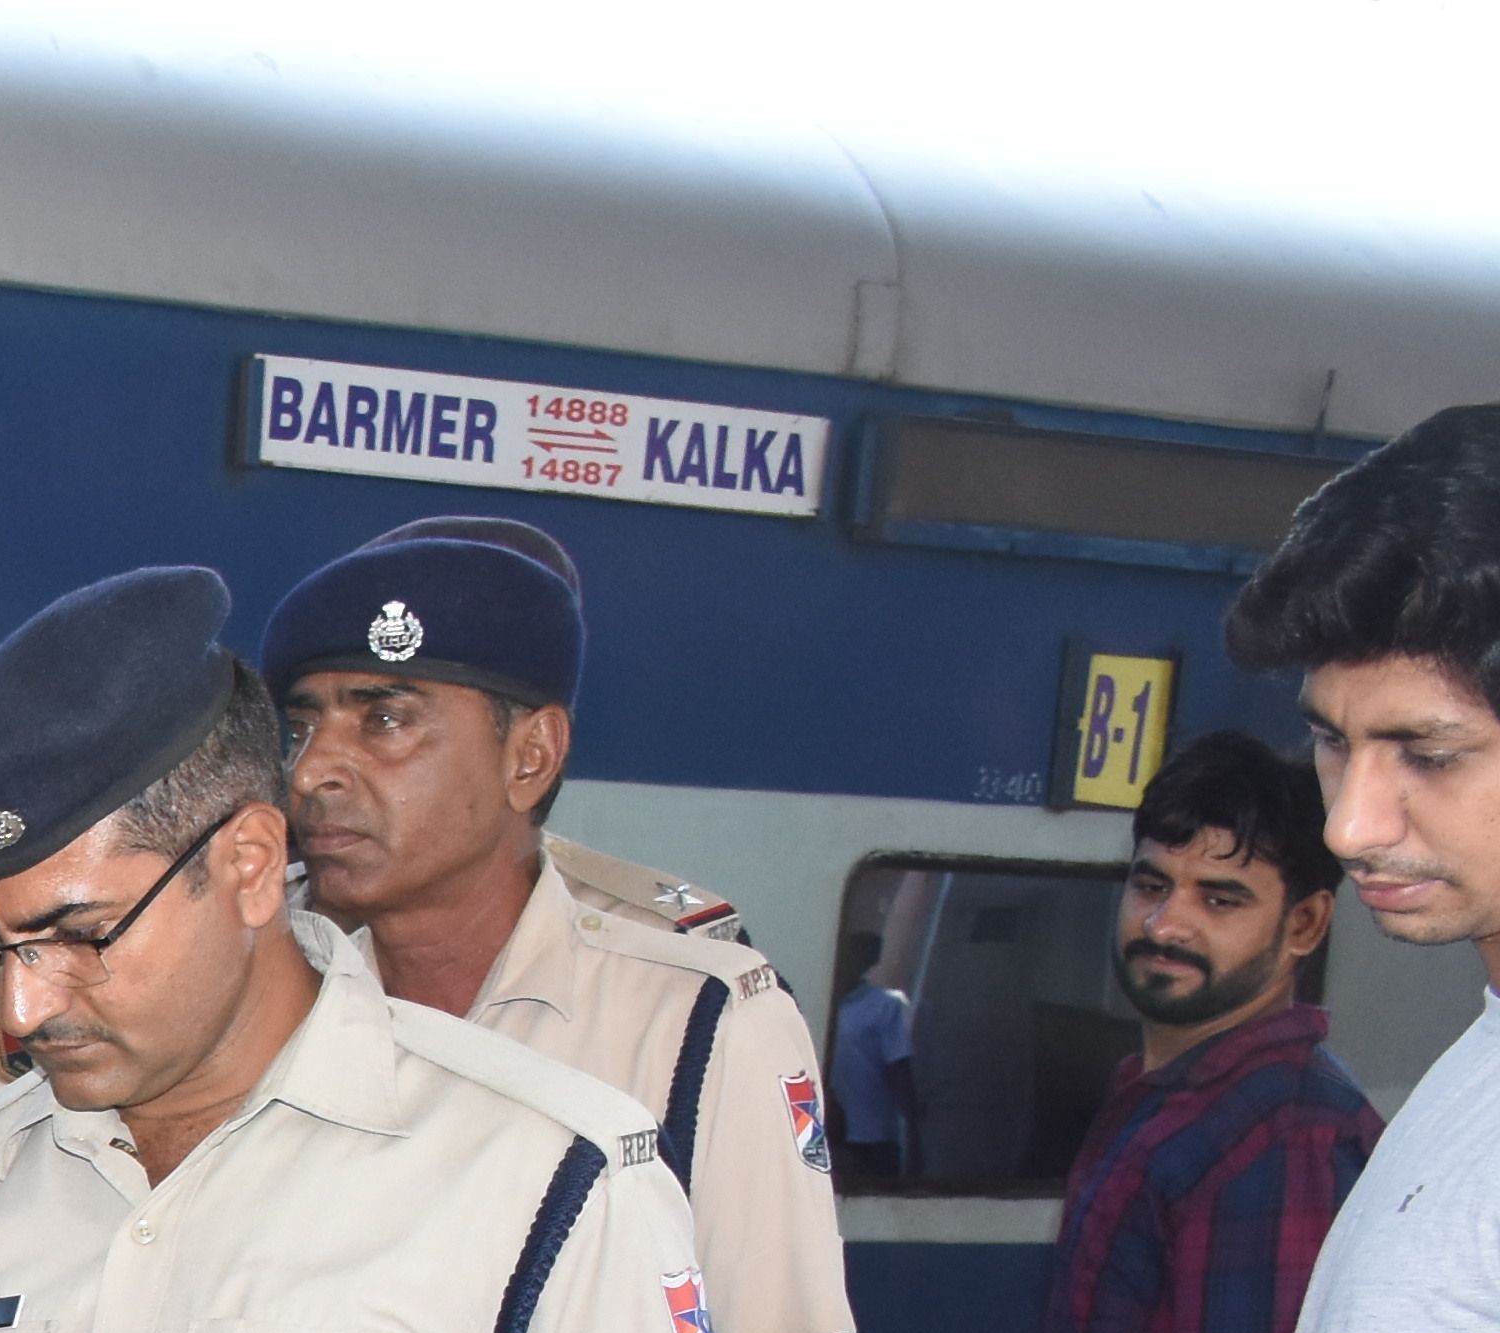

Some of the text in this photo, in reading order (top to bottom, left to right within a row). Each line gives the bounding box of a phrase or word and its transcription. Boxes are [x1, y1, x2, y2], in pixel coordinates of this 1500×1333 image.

[268, 375, 498, 463] BARMER
[526, 395, 629, 427] 14888
[521, 456, 623, 487] 14887
[643, 417, 805, 497] KALKA
[1081, 673, 1152, 784] B-1
